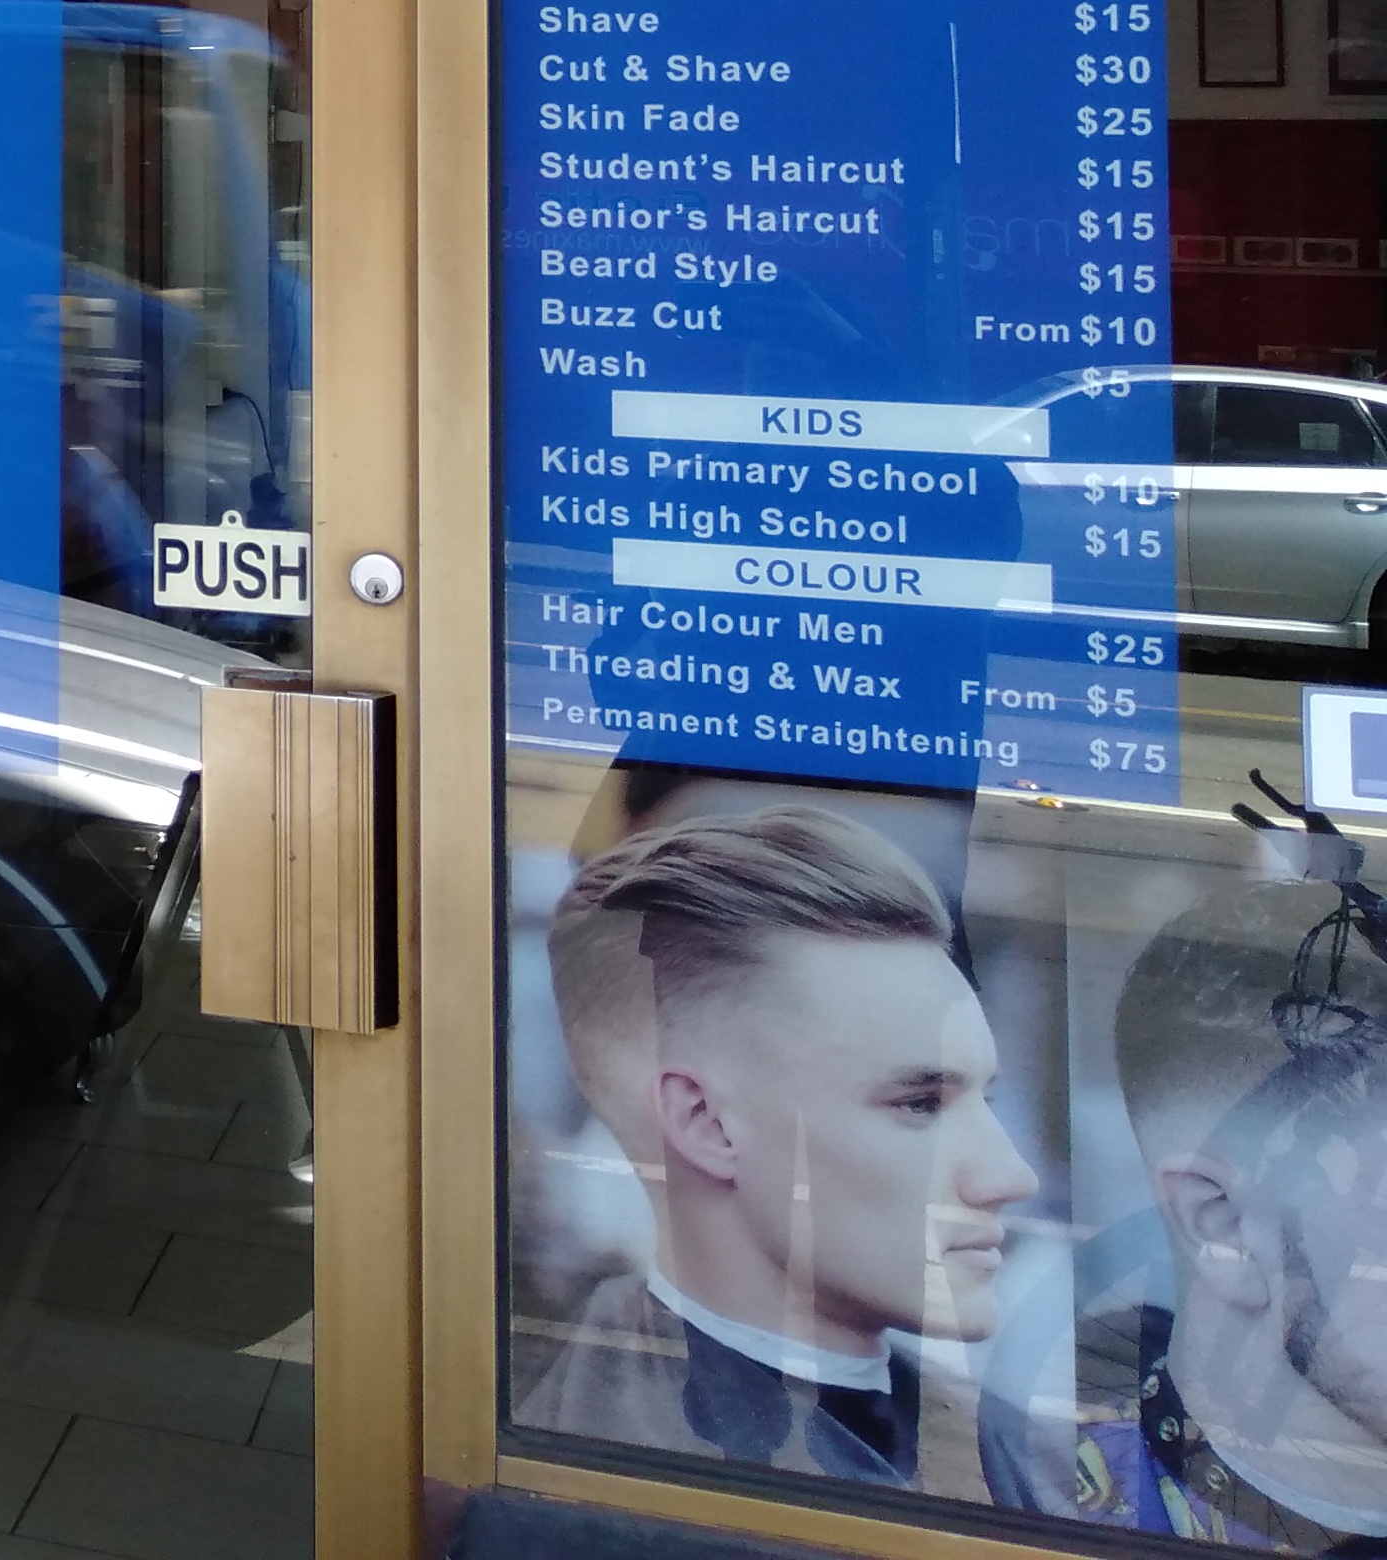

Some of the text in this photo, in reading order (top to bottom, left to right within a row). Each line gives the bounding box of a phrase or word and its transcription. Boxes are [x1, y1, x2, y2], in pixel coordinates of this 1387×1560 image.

[538, 1, 1151, 36] Shave $15
[538, 52, 1151, 87] Cut & Shave $30
[538, 104, 1153, 139] Skin Fade $25
[538, 151, 1154, 192] Student's Haircut $15
[538, 200, 1155, 244] Senior's Haircut $15
[539, 250, 1156, 296] Beard Style $15
[539, 298, 1157, 348] Buzz Cut From $10
[539, 347, 1131, 399] Wash $5
[760, 406, 863, 438] KIDS
[540, 445, 1160, 505] Kids Primary School $10
[540, 495, 1162, 560] Kids High School $15
[157, 537, 308, 602] PUSH
[734, 556, 923, 597] COLOUR
[541, 594, 1165, 666] Hair Colour Men $25
[541, 643, 1137, 718] Threading & Wax From $5
[542, 696, 1167, 774] Permanent Straightening $75
